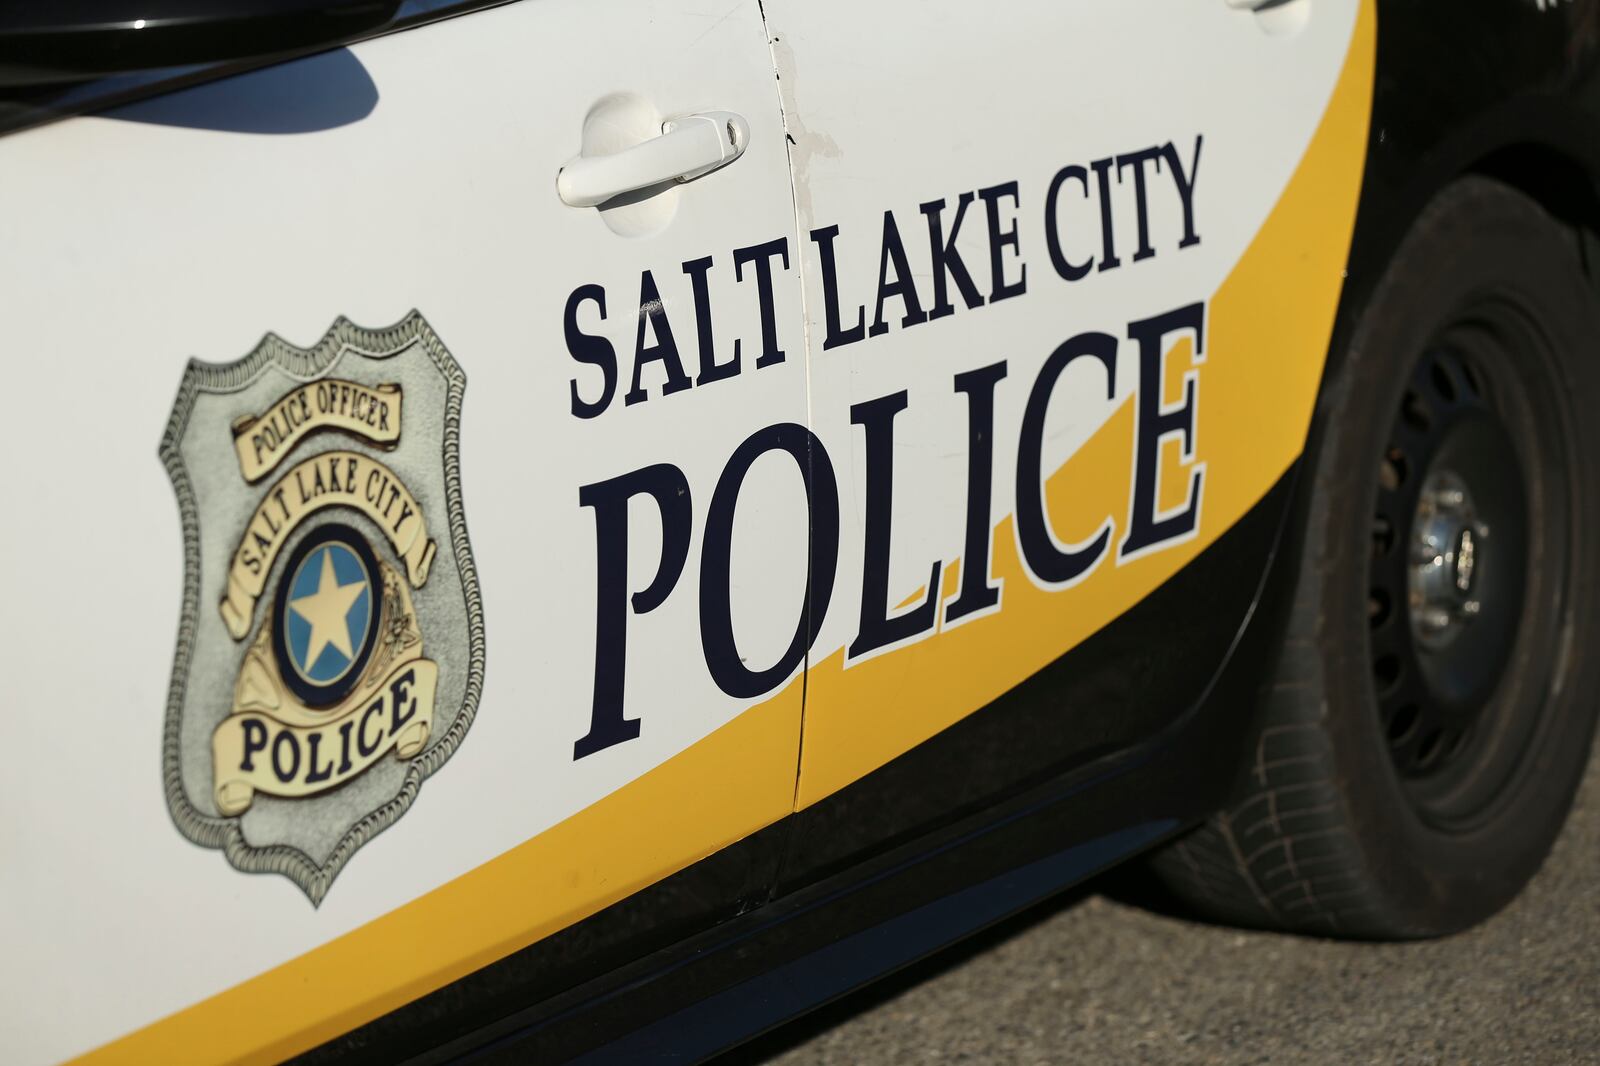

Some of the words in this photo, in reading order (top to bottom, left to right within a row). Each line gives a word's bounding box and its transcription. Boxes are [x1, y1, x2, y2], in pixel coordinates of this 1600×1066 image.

[562, 236, 790, 420] SALT
[810, 180, 1027, 351] LAKE
[1043, 134, 1203, 283] CITY
[253, 391, 312, 465] POLICE
[317, 383, 390, 432] OFFICER
[242, 487, 291, 575] SALT
[296, 458, 358, 503] LAKE
[365, 469, 413, 534] CITY
[573, 300, 1205, 762] POLICE
[239, 667, 419, 785] POLICE
